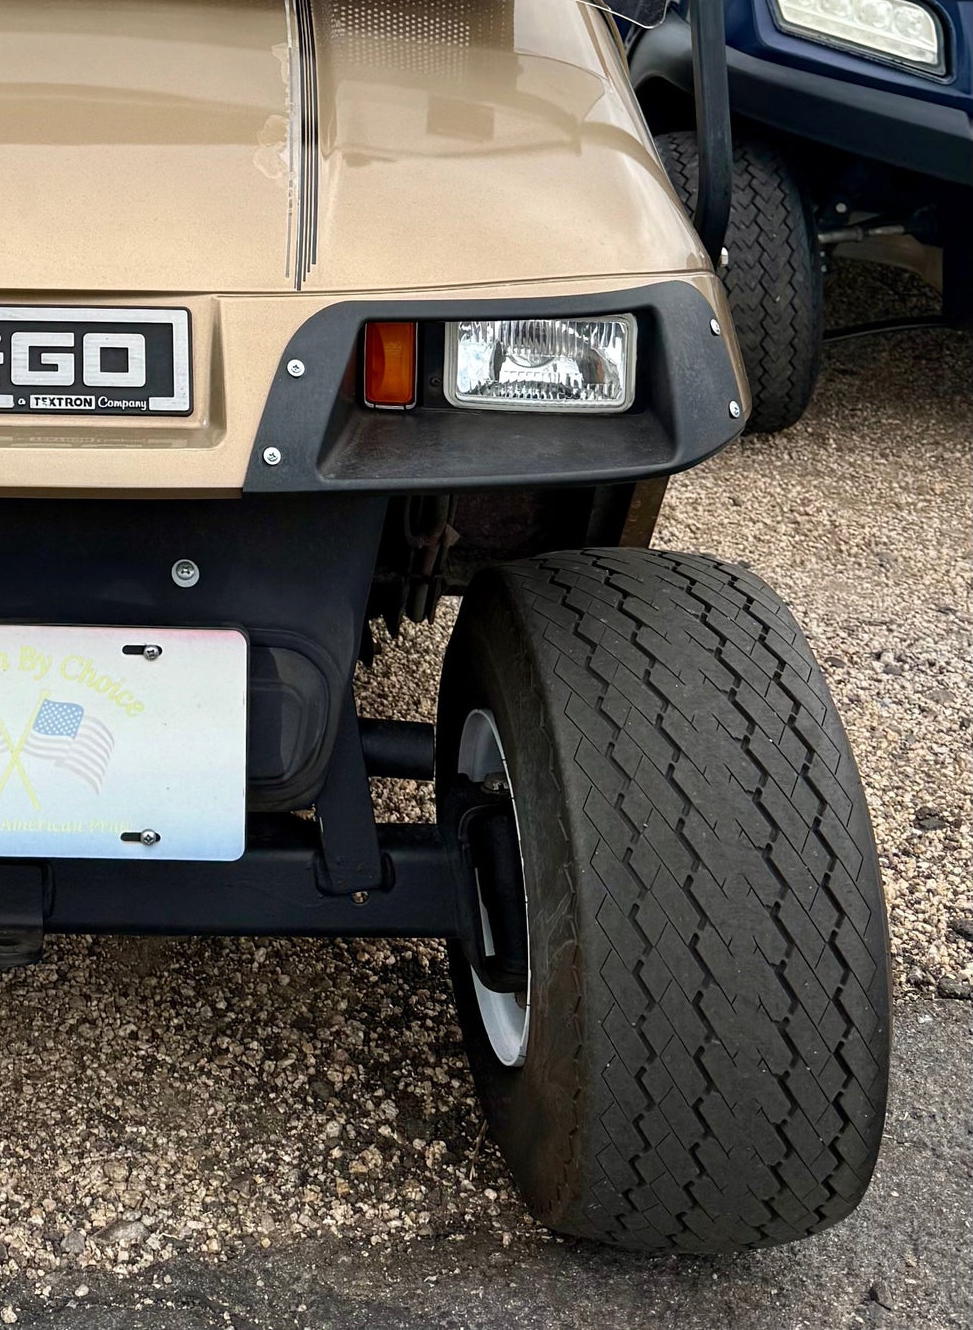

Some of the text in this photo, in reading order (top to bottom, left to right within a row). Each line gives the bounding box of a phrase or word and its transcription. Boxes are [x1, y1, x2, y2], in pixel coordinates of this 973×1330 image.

[17, 397, 27, 406] a
[97, 395, 148, 411] Company
[17, 644, 53, 681] By
[60, 652, 145, 718] Choice
